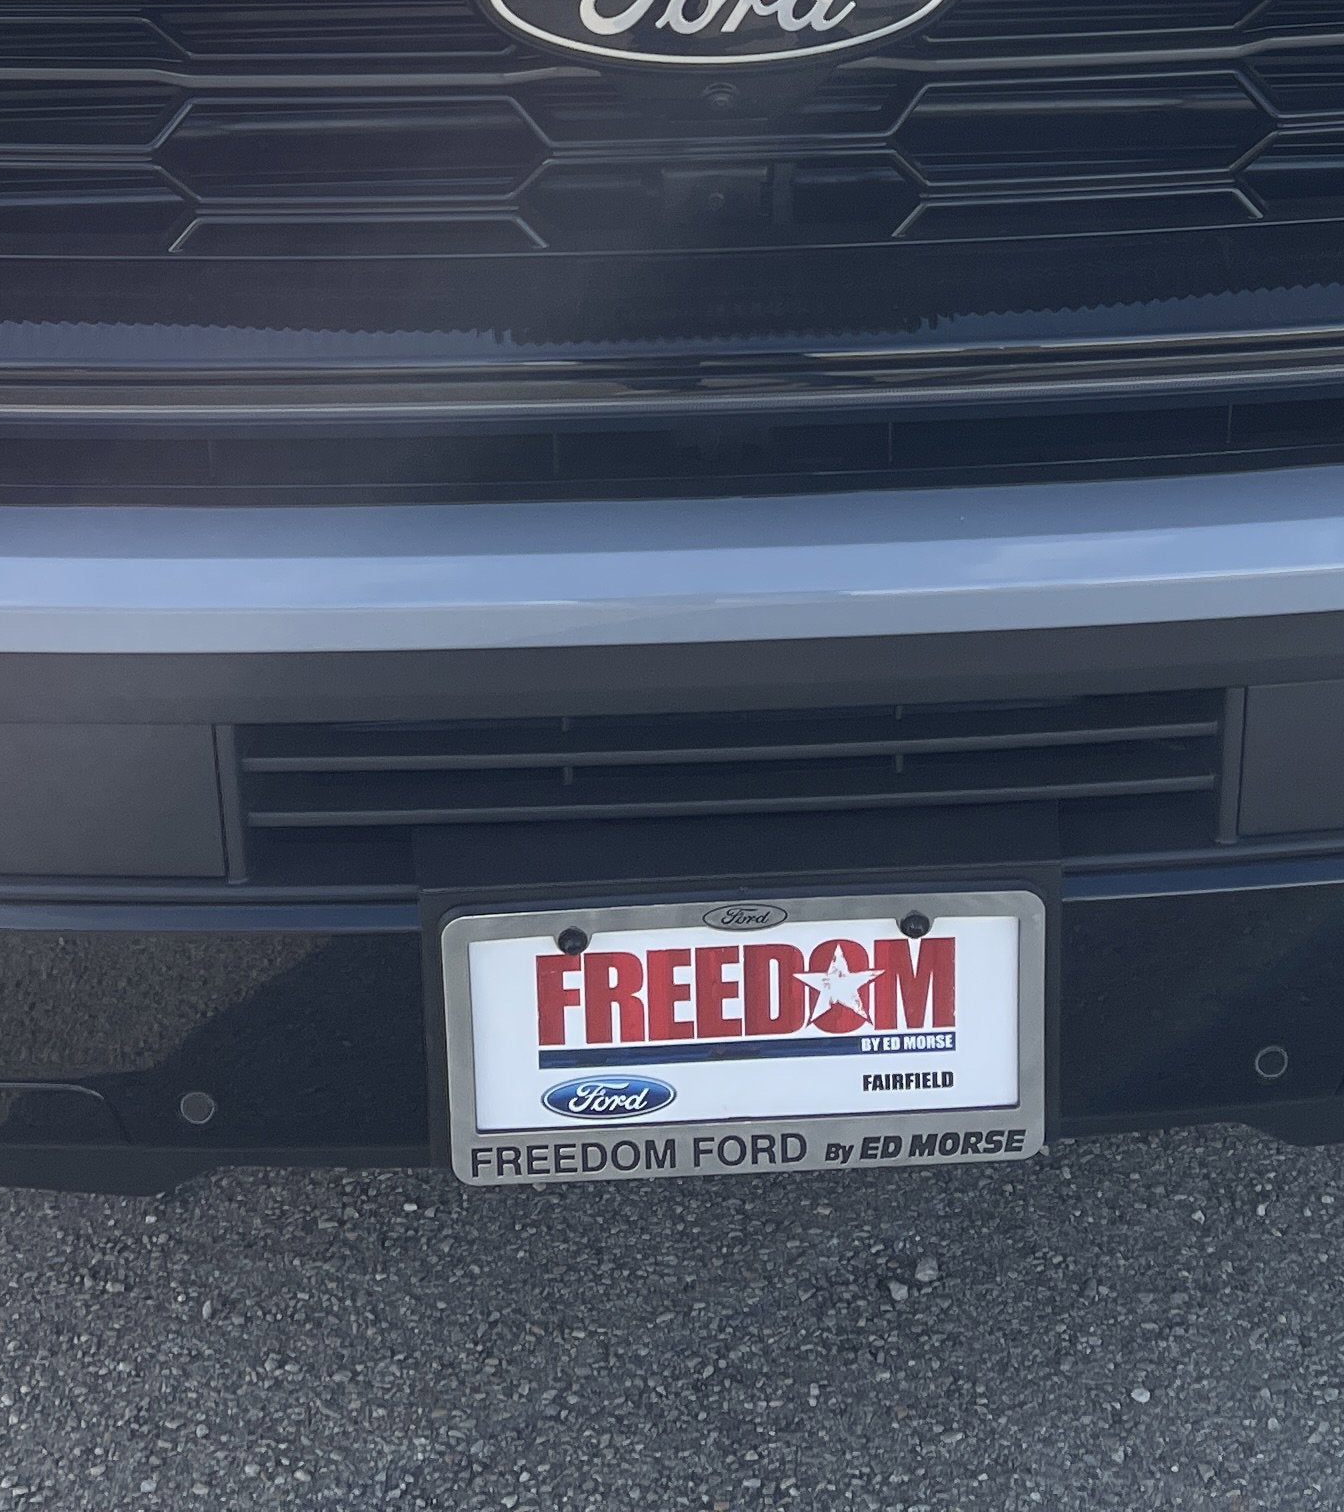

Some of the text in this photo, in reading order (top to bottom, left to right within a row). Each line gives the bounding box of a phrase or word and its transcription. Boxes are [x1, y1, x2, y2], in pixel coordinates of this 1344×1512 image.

[721, 908, 771, 925] Ford
[535, 937, 956, 1046] FREEDOM
[860, 1033, 953, 1052] BY ED MORSE
[862, 1071, 954, 1092] FAIRFIELD
[567, 1081, 650, 1114] Ford
[470, 1128, 1027, 1178] FREEDOM FORD By ED MORSE
